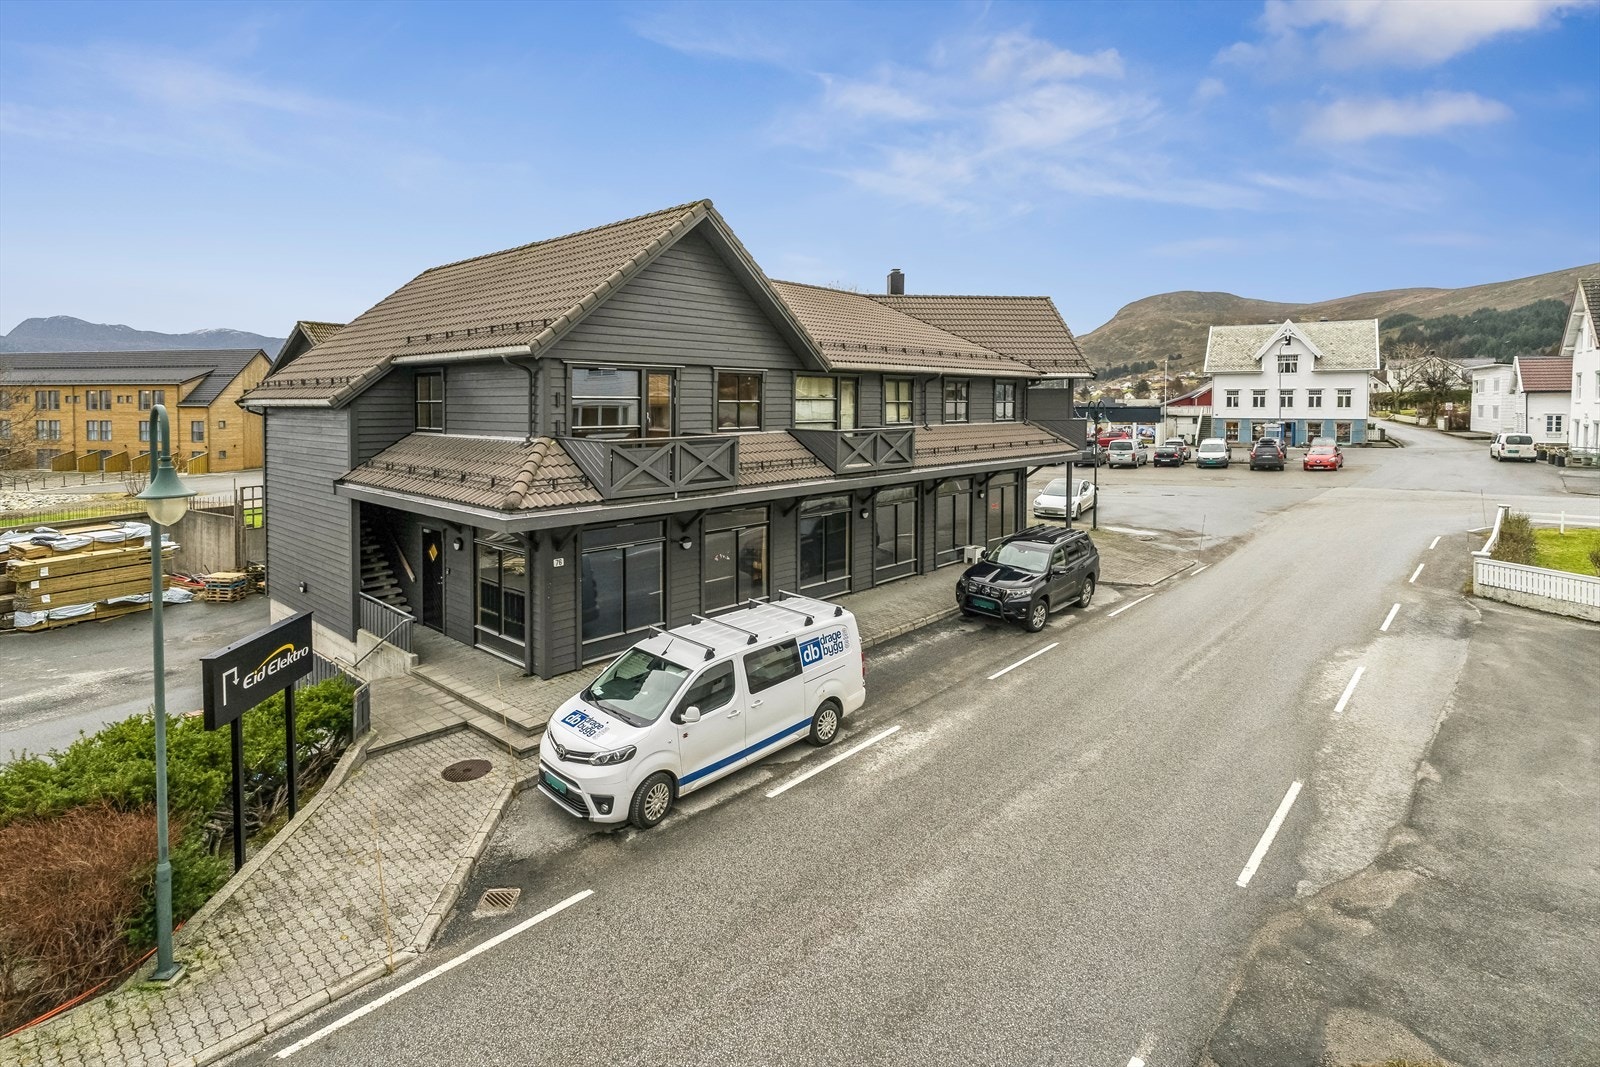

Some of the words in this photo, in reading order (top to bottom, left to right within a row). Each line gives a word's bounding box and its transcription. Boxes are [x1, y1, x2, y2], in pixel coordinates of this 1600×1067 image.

[820, 630, 841, 646] drage
[803, 643, 820, 663] db
[822, 640, 844, 656] bygg
[243, 665, 266, 689] Eid
[267, 646, 309, 675] Elektro
[565, 713, 582, 726] db
[584, 716, 604, 730] drage
[576, 722, 596, 738] bygg
